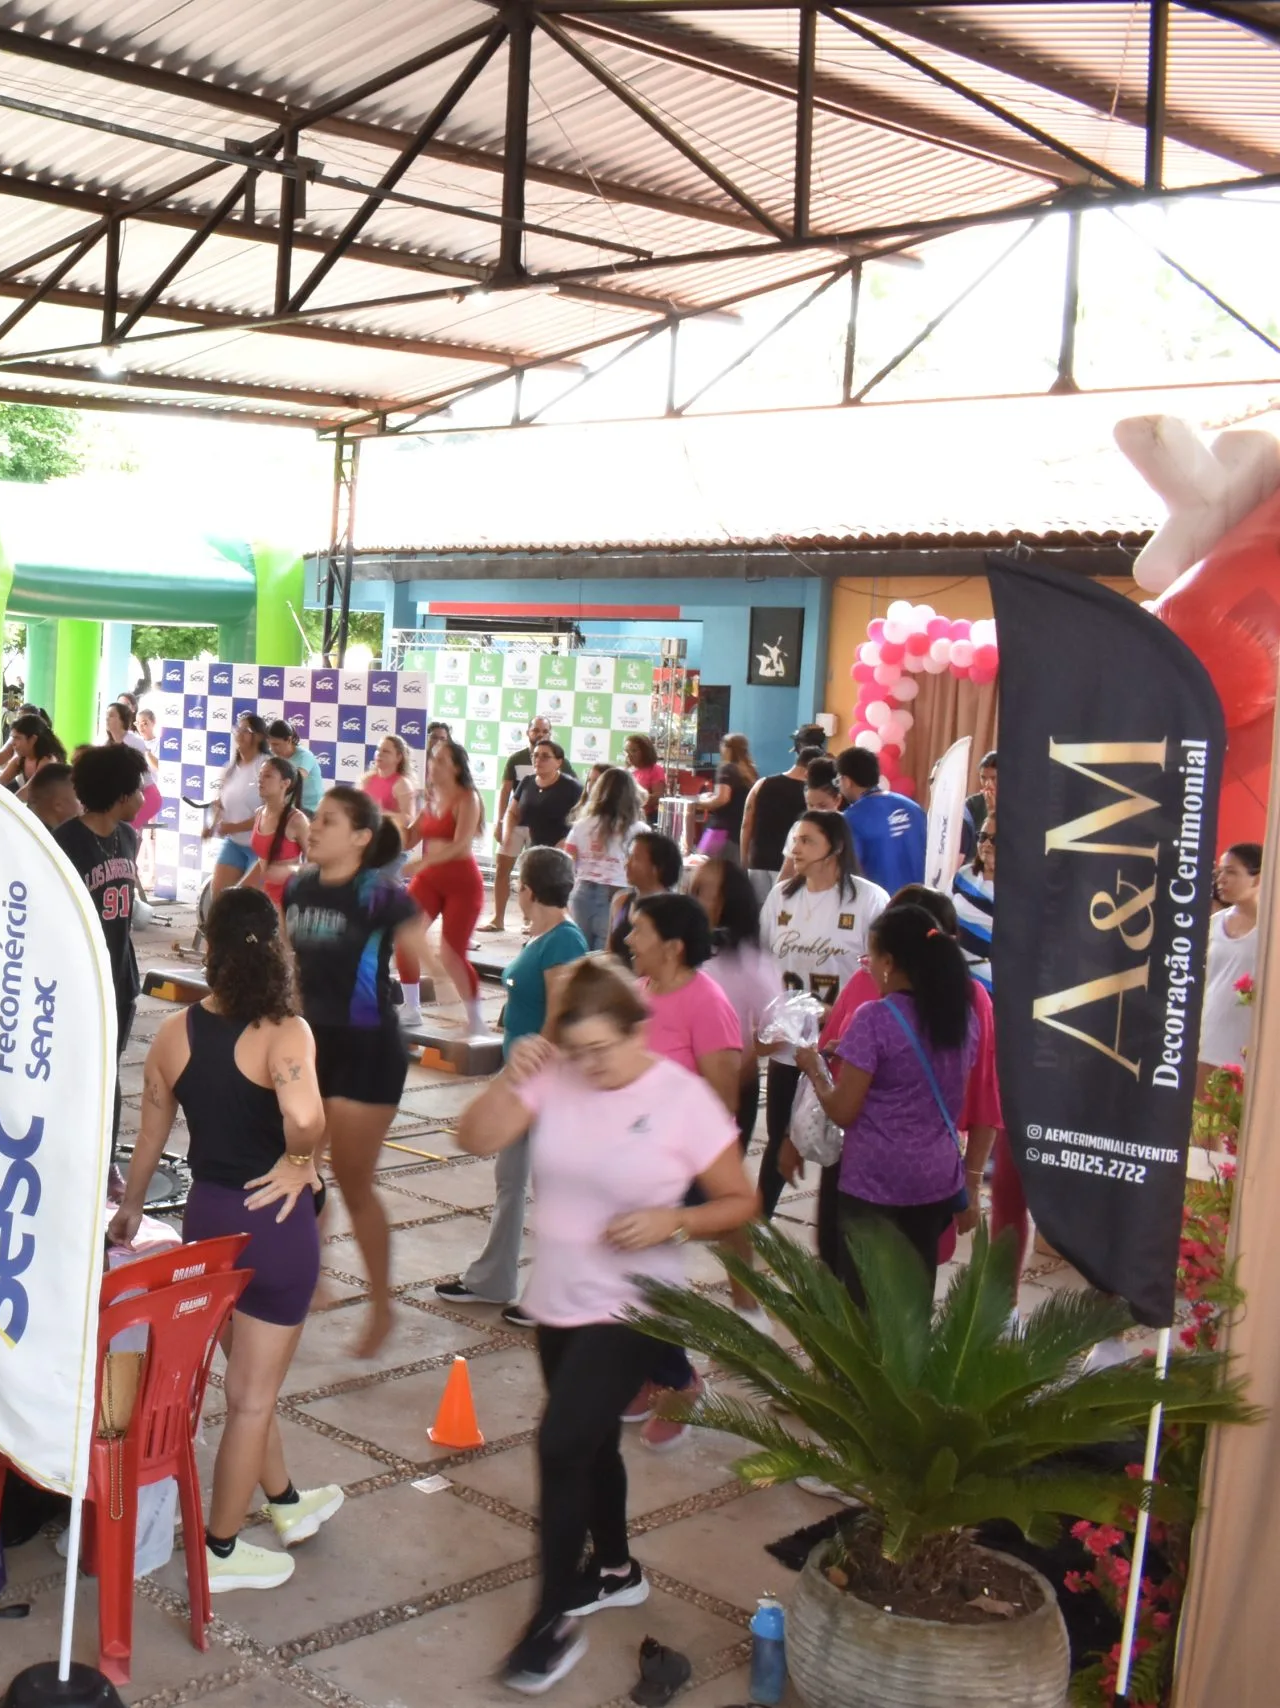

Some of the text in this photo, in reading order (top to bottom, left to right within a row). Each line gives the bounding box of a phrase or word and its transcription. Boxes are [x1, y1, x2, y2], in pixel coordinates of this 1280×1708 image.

[402, 684, 422, 693] Sesc
[314, 719, 332, 728] Sesc
[401, 724, 420, 735] Sesc
[341, 758, 360, 768] Sesc
[102, 884, 130, 920] 91
[1032, 735, 1168, 1083] A&M
[1152, 739, 1209, 1090] Decoração e Cerimonial
[771, 930, 850, 967] Brooklyn
[1045, 1128, 1179, 1163] AEMCERIMONIALEEVENTOS
[1041, 1150, 1148, 1184] 89.98125.2722
[172, 1263, 206, 1282] BRAHMA
[179, 1296, 208, 1312] BRAHMA
